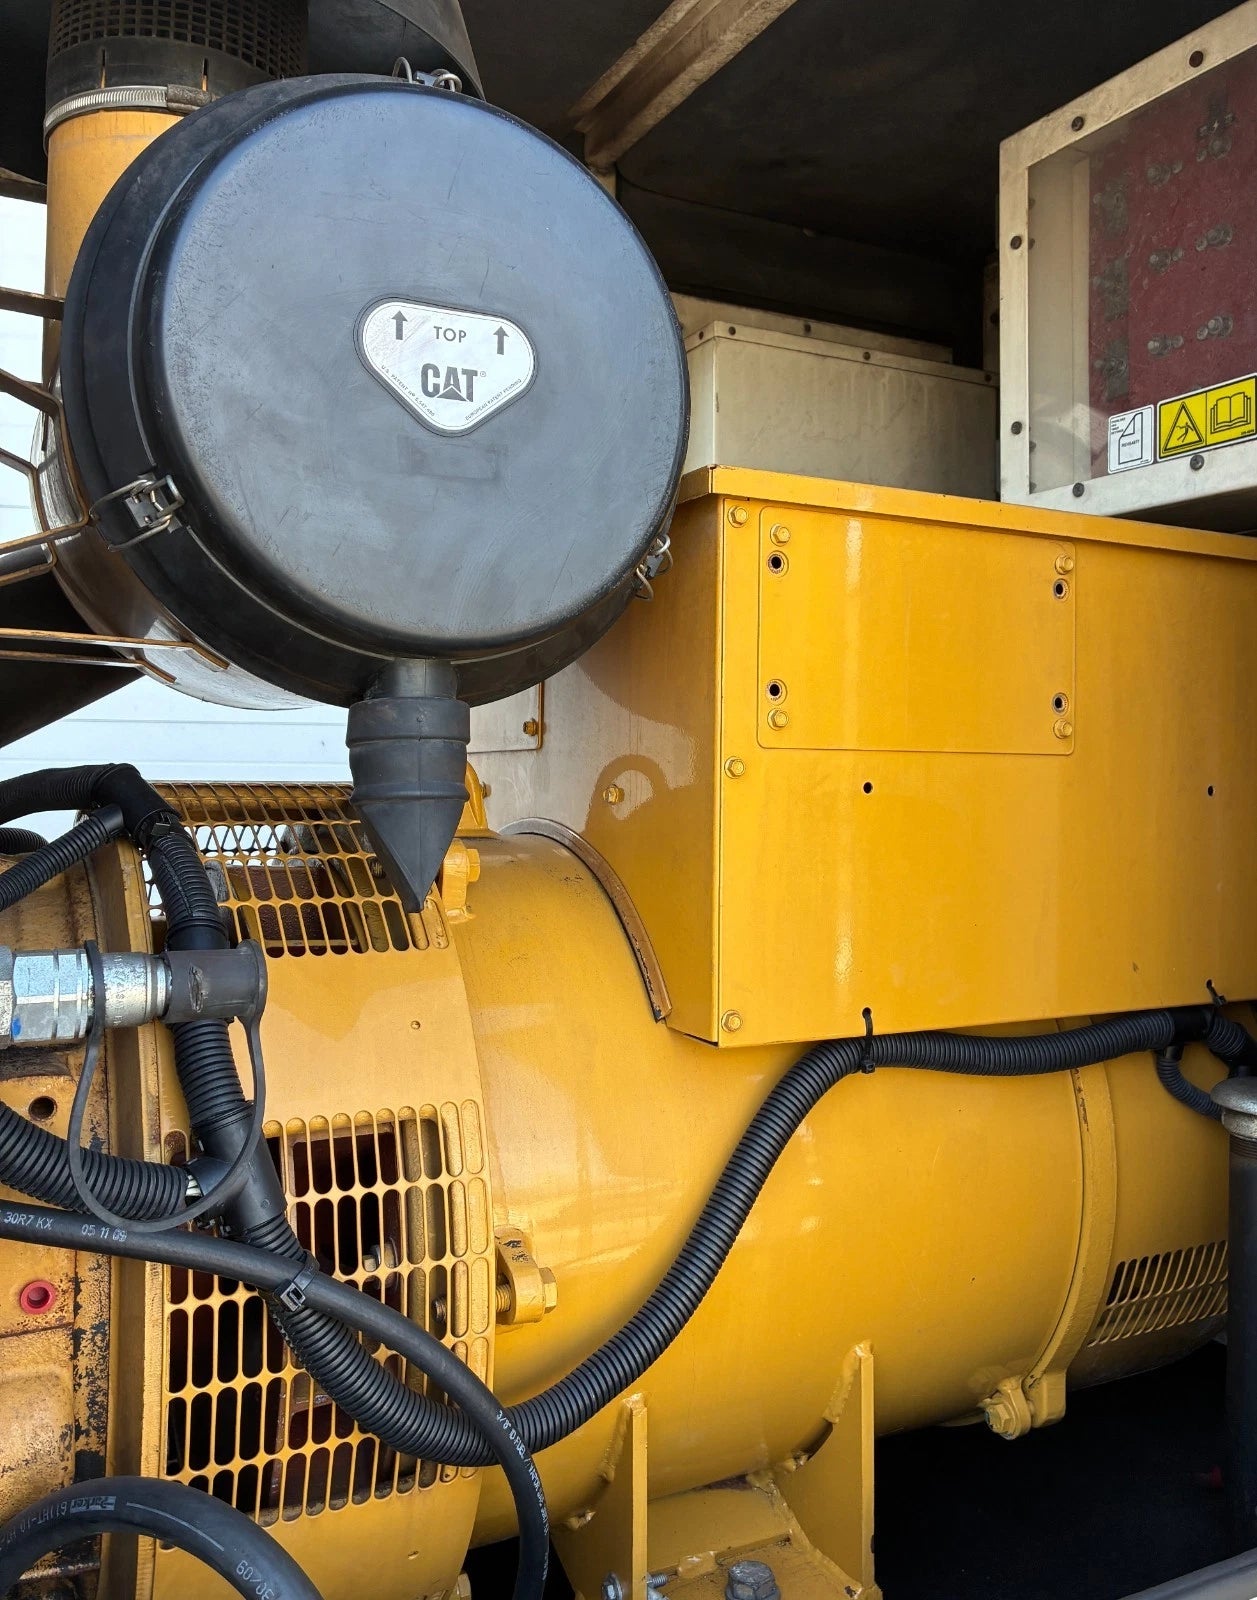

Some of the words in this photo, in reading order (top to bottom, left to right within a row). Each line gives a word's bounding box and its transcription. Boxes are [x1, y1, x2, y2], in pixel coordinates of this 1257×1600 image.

[433, 325, 467, 343] TOP
[4, 1211, 34, 1226] 30R7
[35, 1216, 54, 1231] KX
[81, 1223, 96, 1237] 05
[70, 1496, 113, 1512] Parker
